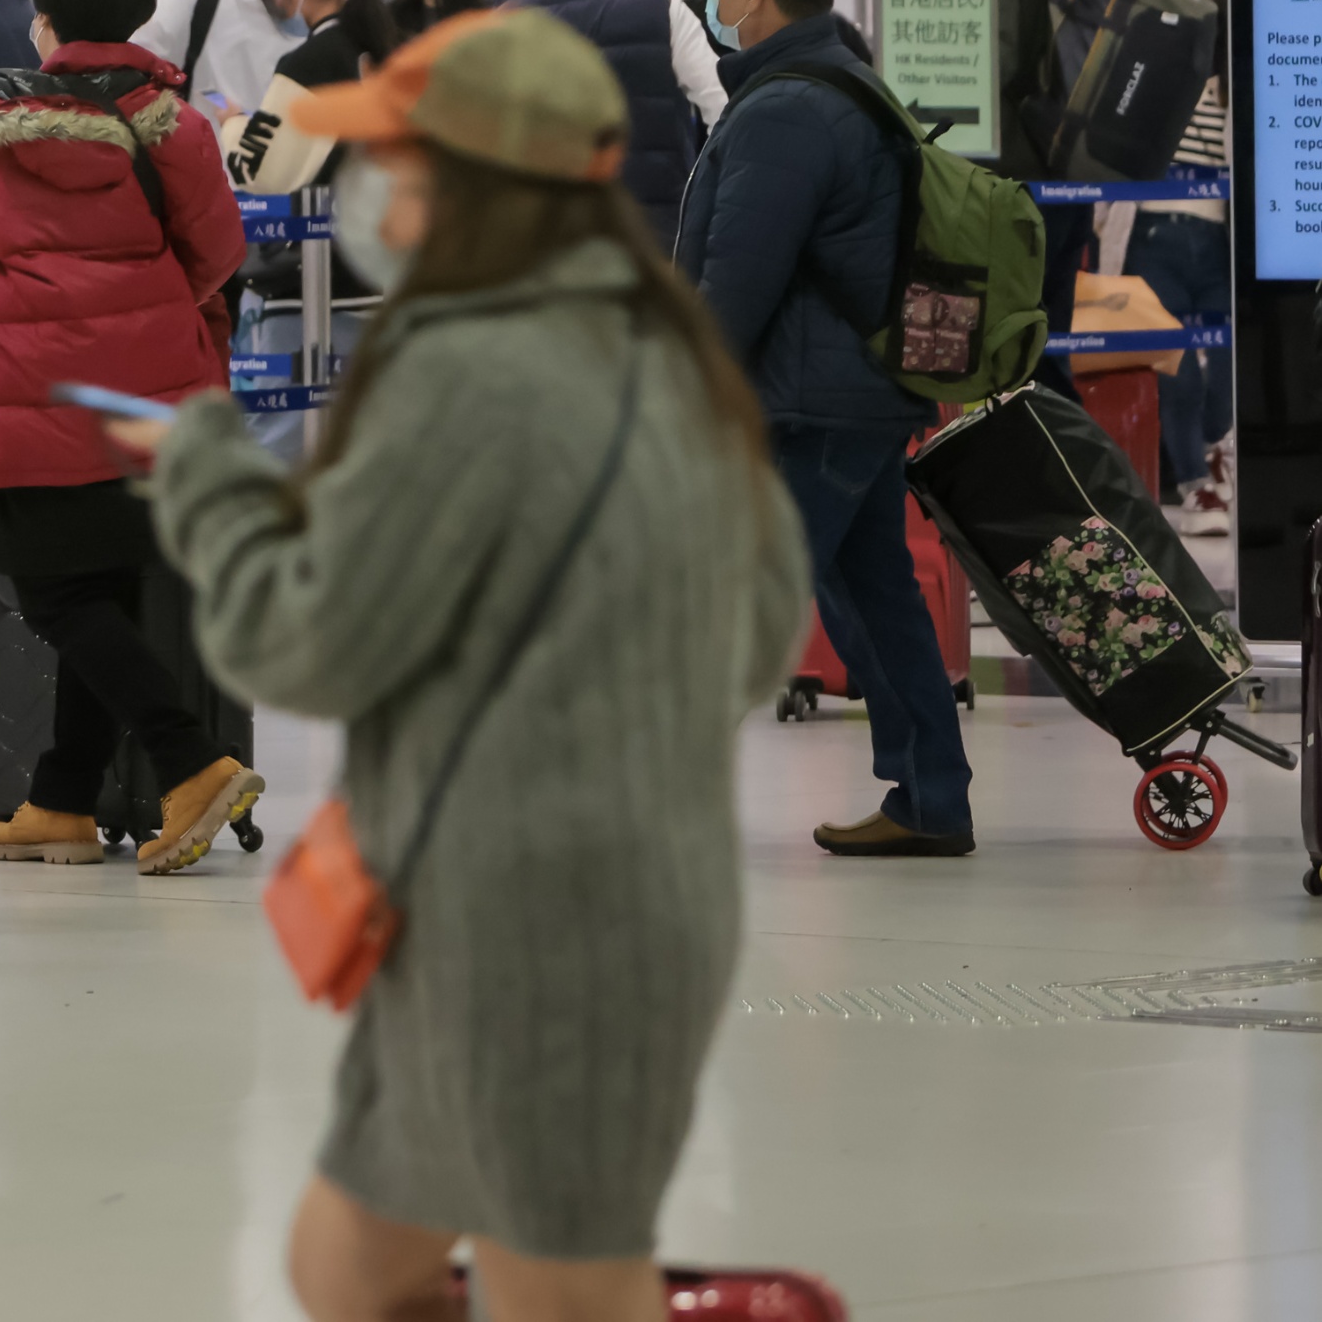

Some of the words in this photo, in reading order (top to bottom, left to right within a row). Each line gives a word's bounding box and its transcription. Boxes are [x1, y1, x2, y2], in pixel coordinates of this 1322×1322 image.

[1267, 32, 1309, 45] Please
[895, 54, 911, 65] HK
[914, 54, 970, 66] Residents
[898, 73, 930, 85] Other
[934, 73, 978, 86] Visitors
[1268, 74, 1279, 87] 1.
[1294, 74, 1317, 87] The
[1116, 60, 1145, 116] FORCLAZ
[1268, 116, 1280, 129] 2.
[1294, 116, 1322, 129] COV
[1041, 185, 1103, 199] Immigration
[1269, 200, 1281, 213] 3.
